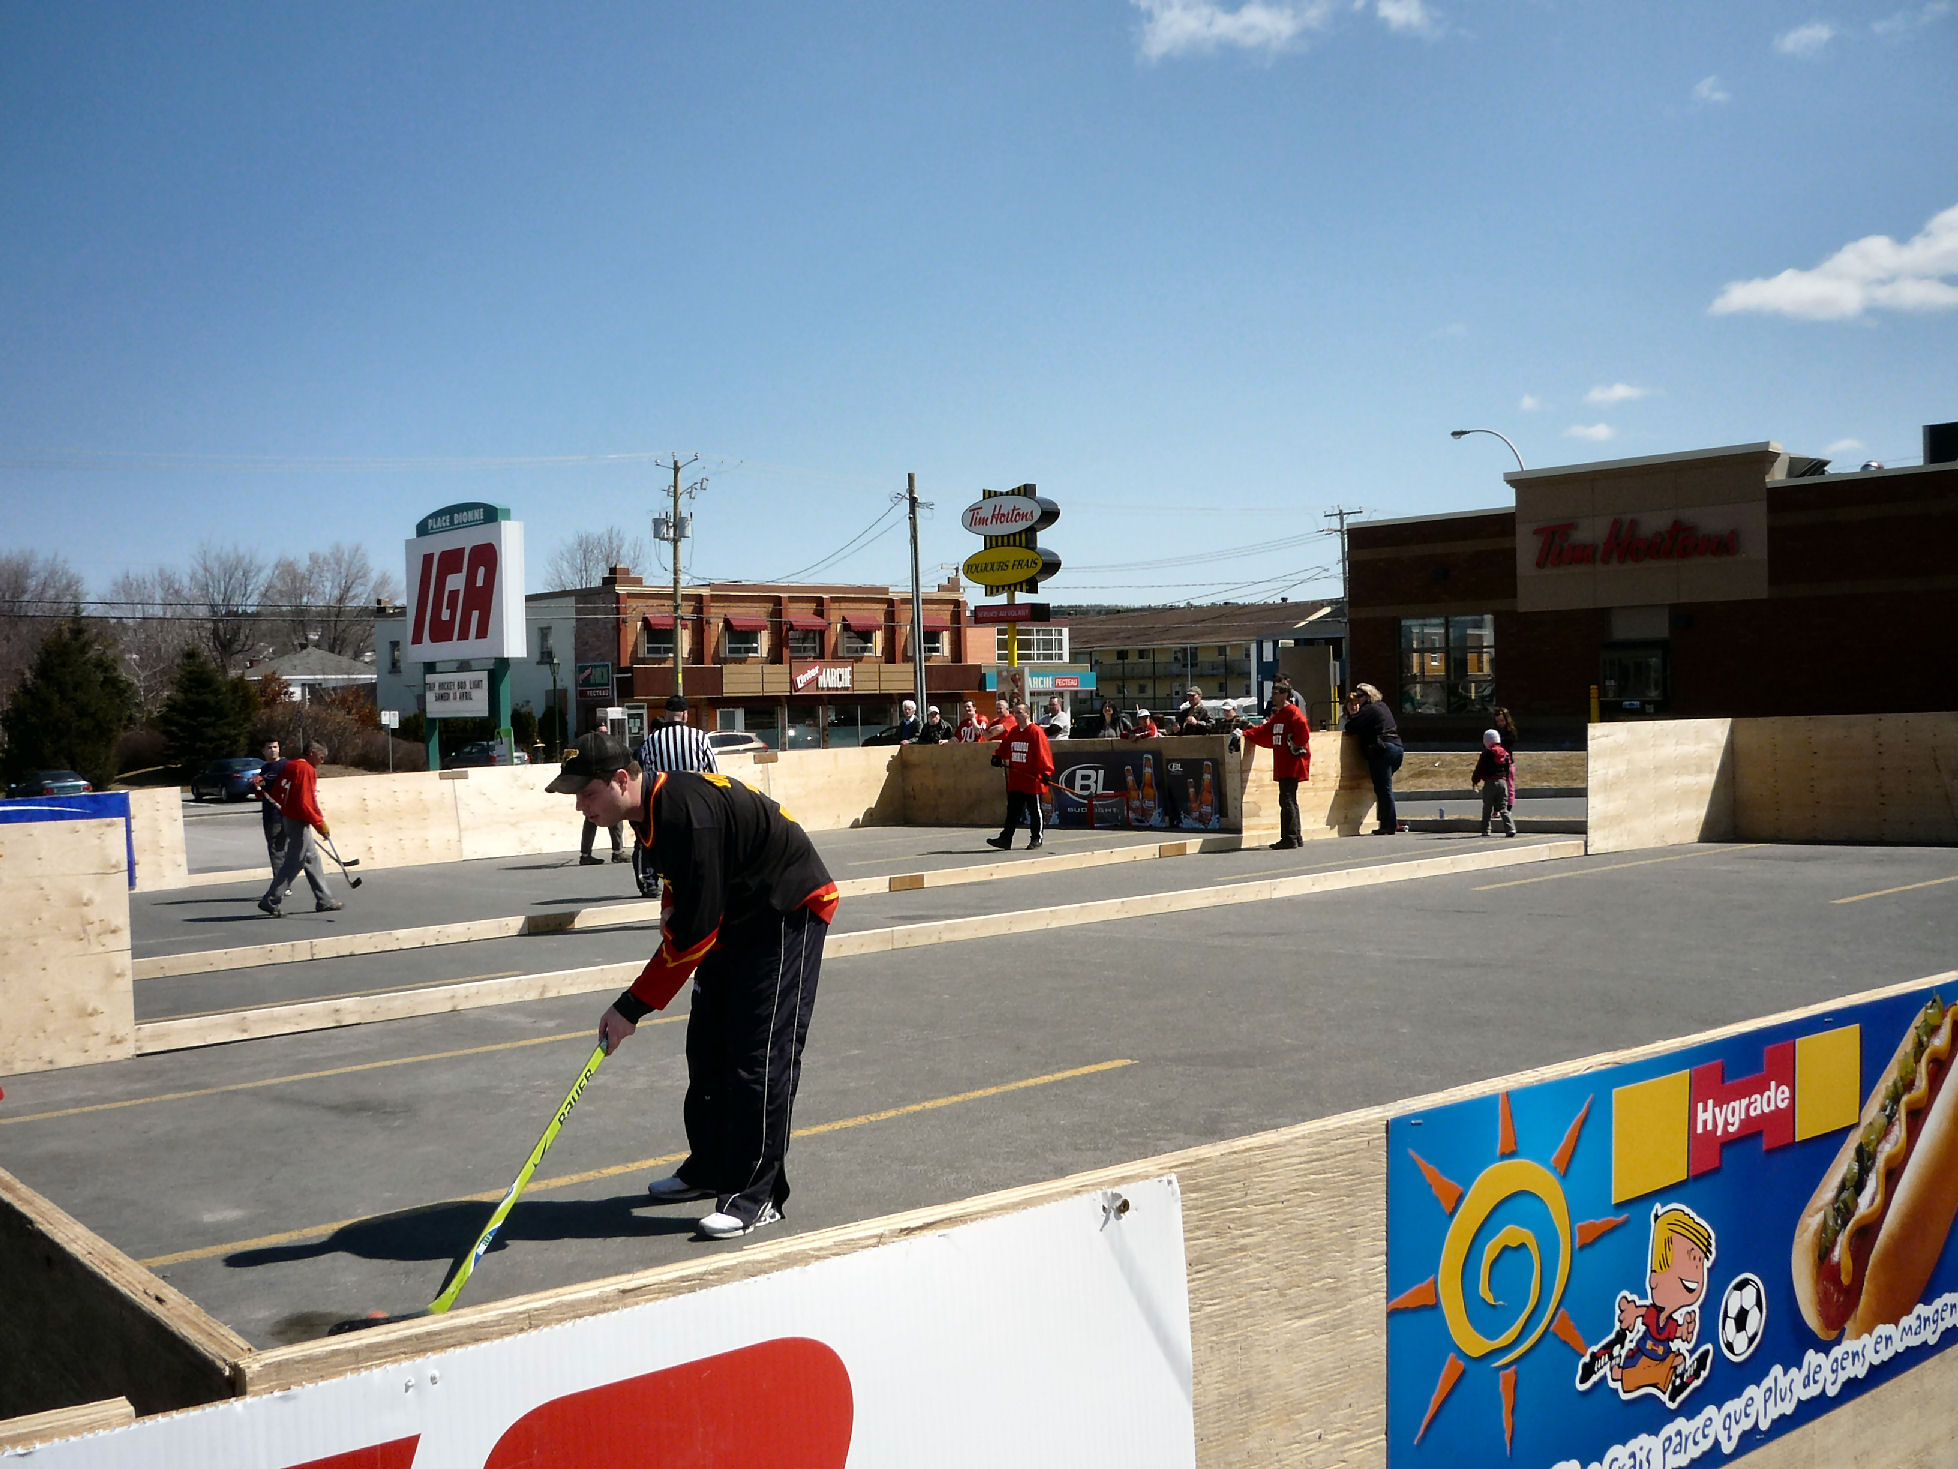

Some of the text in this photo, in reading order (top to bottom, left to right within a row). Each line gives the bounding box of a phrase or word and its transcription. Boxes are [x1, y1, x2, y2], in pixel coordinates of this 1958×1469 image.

[428, 507, 484, 530] PLACE DIONNE
[969, 504, 1034, 527] Tim Hortons
[1533, 518, 1738, 569] Tim Hortons
[966, 558, 1039, 575] TOUJOURS FRAIS
[411, 542, 498, 646] IGA
[1074, 769, 1115, 796] BL
[1696, 1080, 1790, 1137] Hygrade
[1722, 1395, 1755, 1443] que
[1763, 1375, 1795, 1420] plus
[1802, 1359, 1823, 1390] de
[1830, 1343, 1867, 1386] gens
[1873, 1332, 1894, 1355] en
